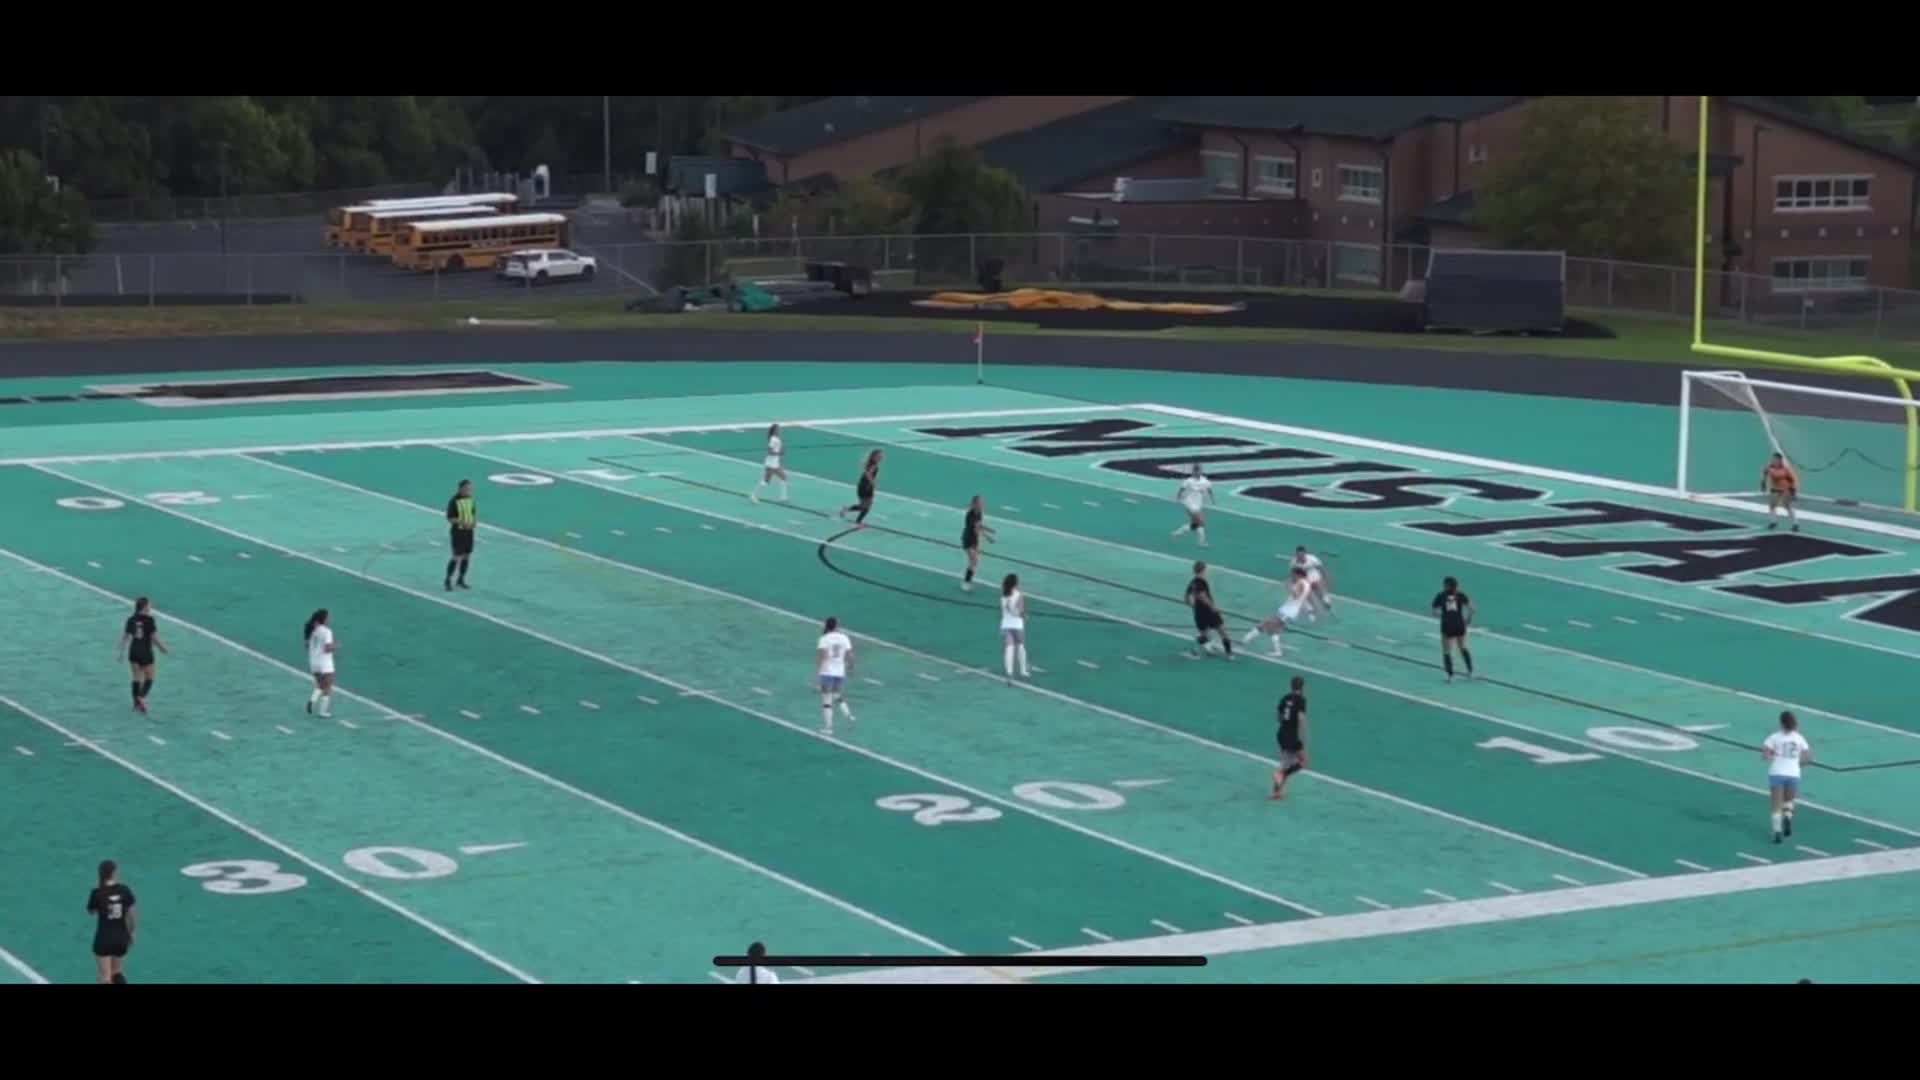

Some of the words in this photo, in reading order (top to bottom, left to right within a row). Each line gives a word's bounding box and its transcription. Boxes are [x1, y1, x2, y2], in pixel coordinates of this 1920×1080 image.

[1475, 726, 1699, 764] 10
[875, 780, 1126, 825] 20
[179, 846, 458, 894] 30
